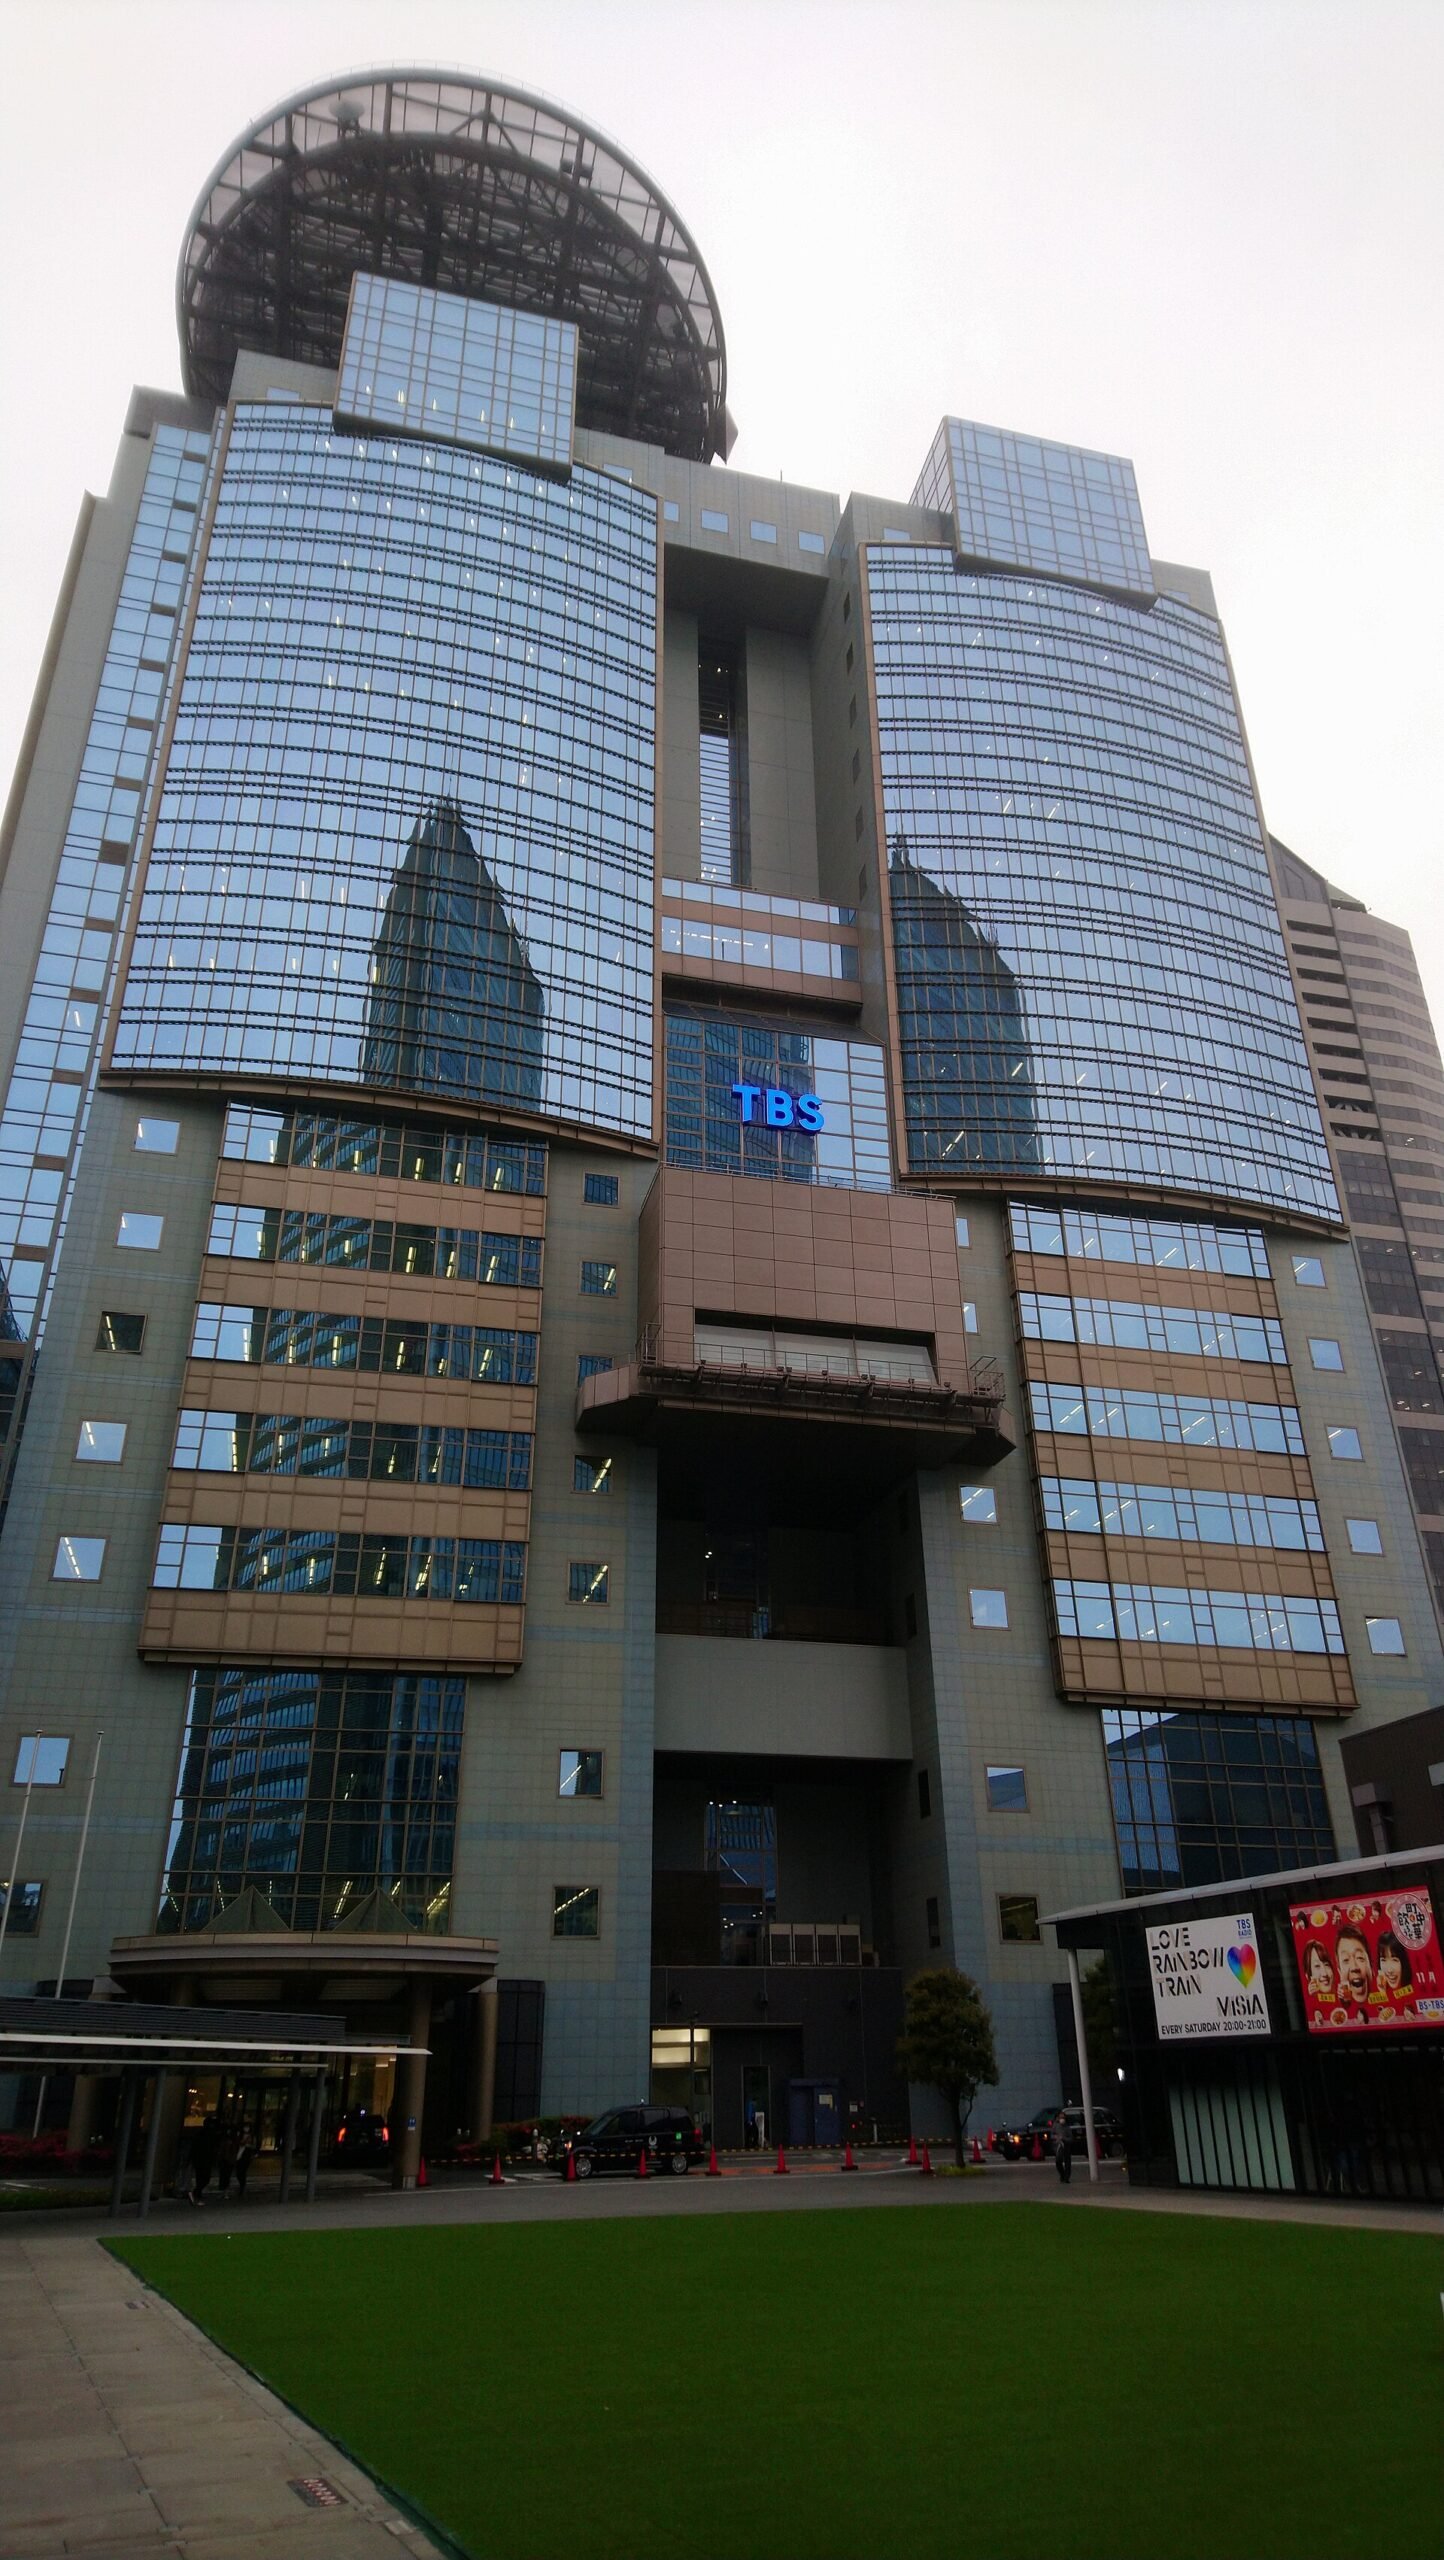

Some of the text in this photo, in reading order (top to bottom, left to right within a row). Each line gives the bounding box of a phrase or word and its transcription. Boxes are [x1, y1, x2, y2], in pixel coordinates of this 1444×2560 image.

[731, 1084, 825, 1136] TBS
[1236, 1919, 1251, 1929] TBS
[1150, 1927, 1191, 1950] LOVE
[1161, 2019, 1267, 2035] EVERY SATURDAY 20:00-21:00
